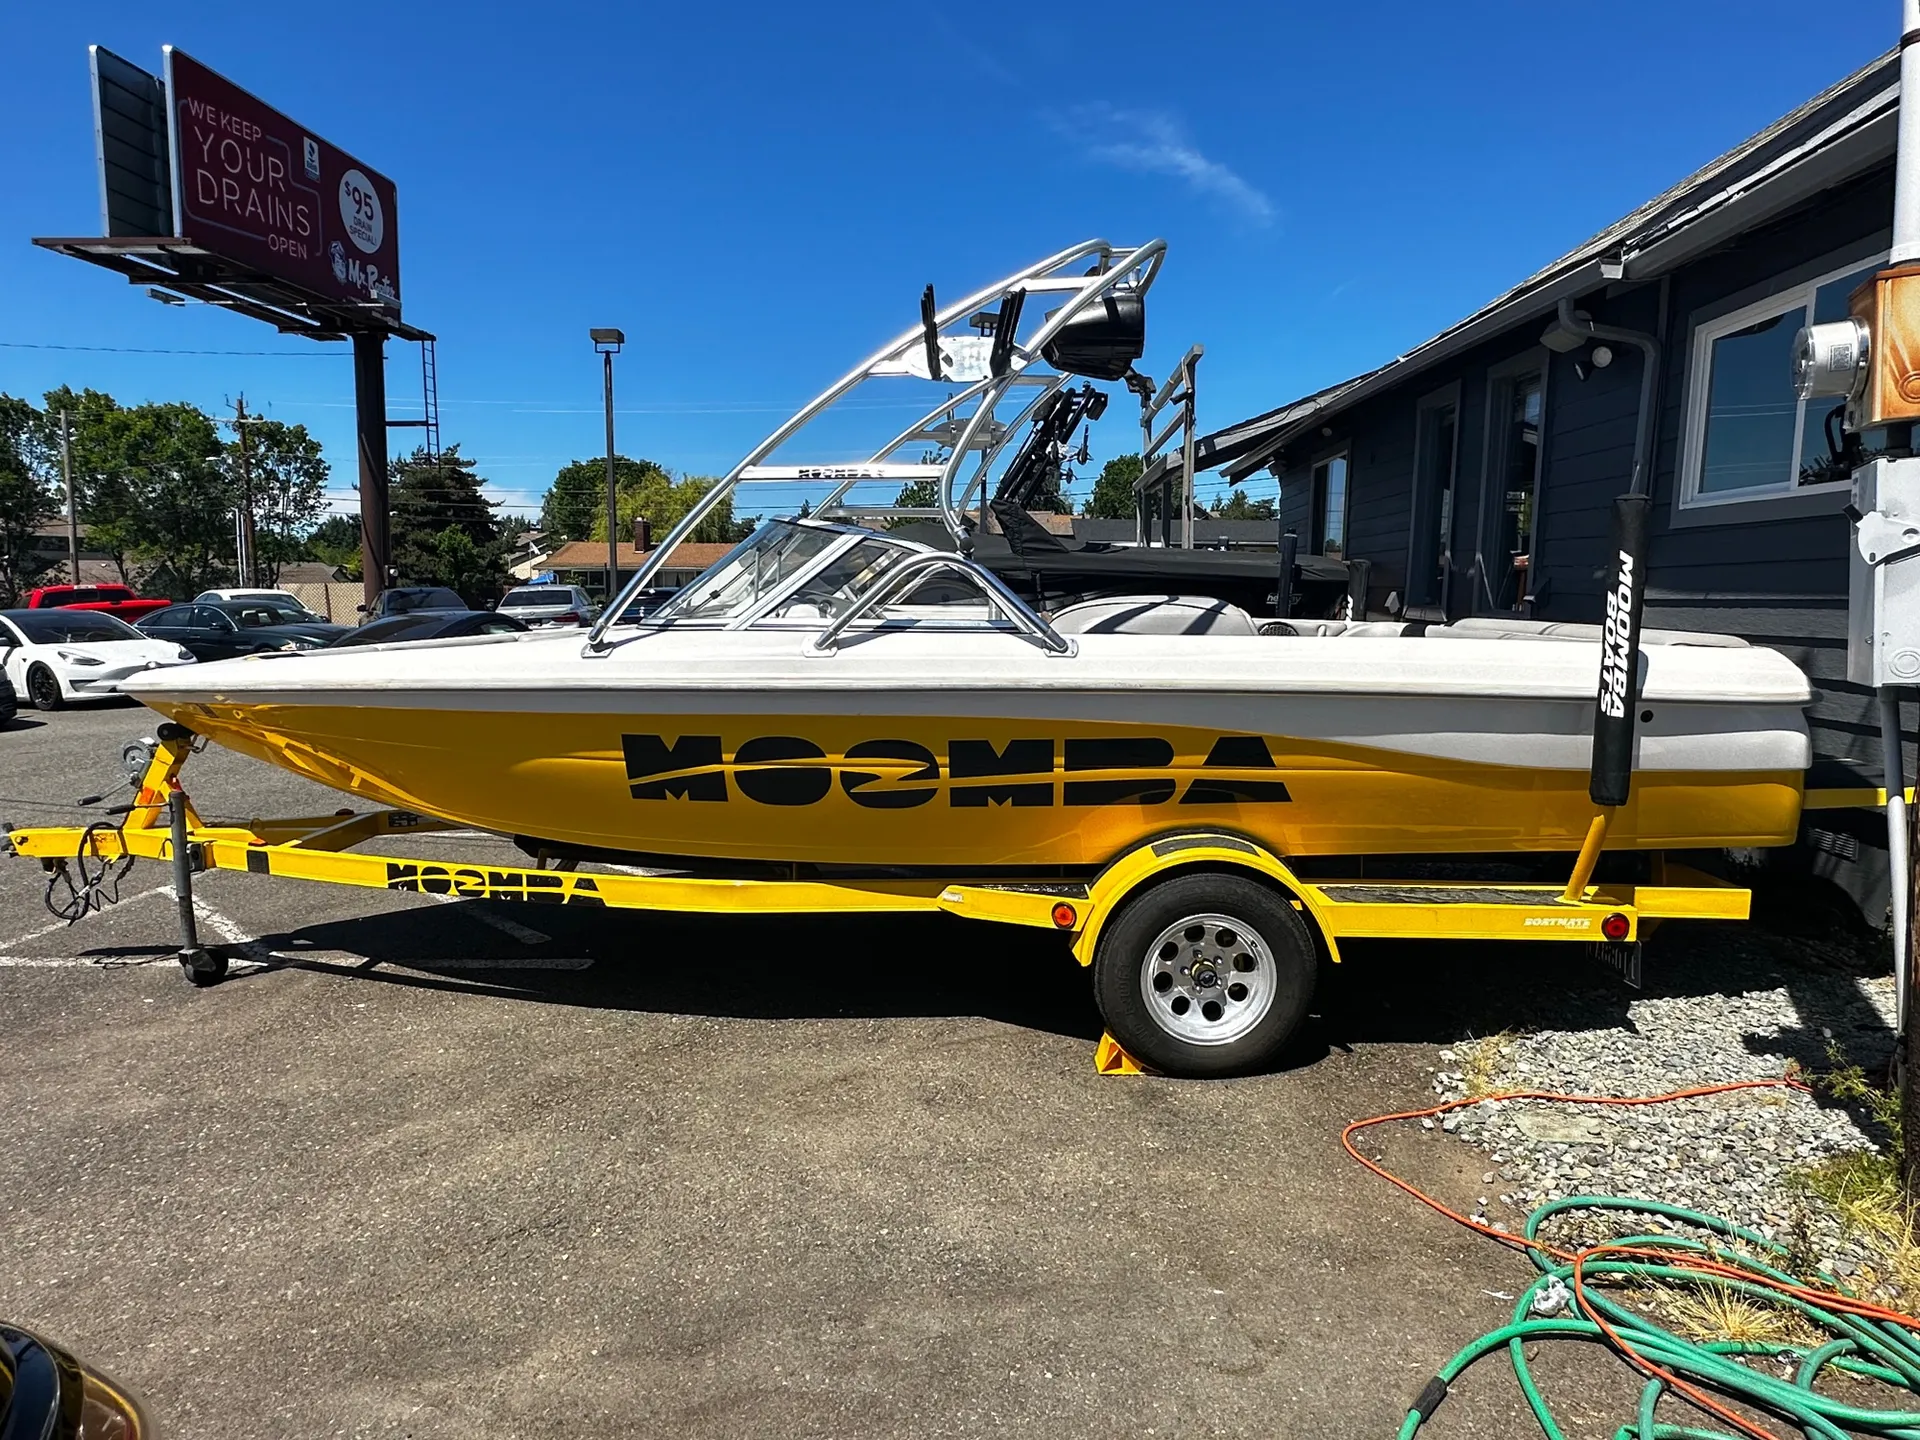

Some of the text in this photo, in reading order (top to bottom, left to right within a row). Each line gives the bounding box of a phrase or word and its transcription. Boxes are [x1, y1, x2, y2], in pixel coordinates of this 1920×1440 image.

[187, 97, 262, 142] WE KEEP
[194, 126, 285, 192] YOUR
[196, 168, 311, 237] DRAINS
[344, 180, 374, 221] $95
[268, 233, 308, 260] OPEN
[1600, 590, 1617, 717] BOATS
[1611, 550, 1634, 718] MOOMBA
[620, 733, 1292, 809] MOOMBA
[386, 862, 607, 906] MOOMBA
